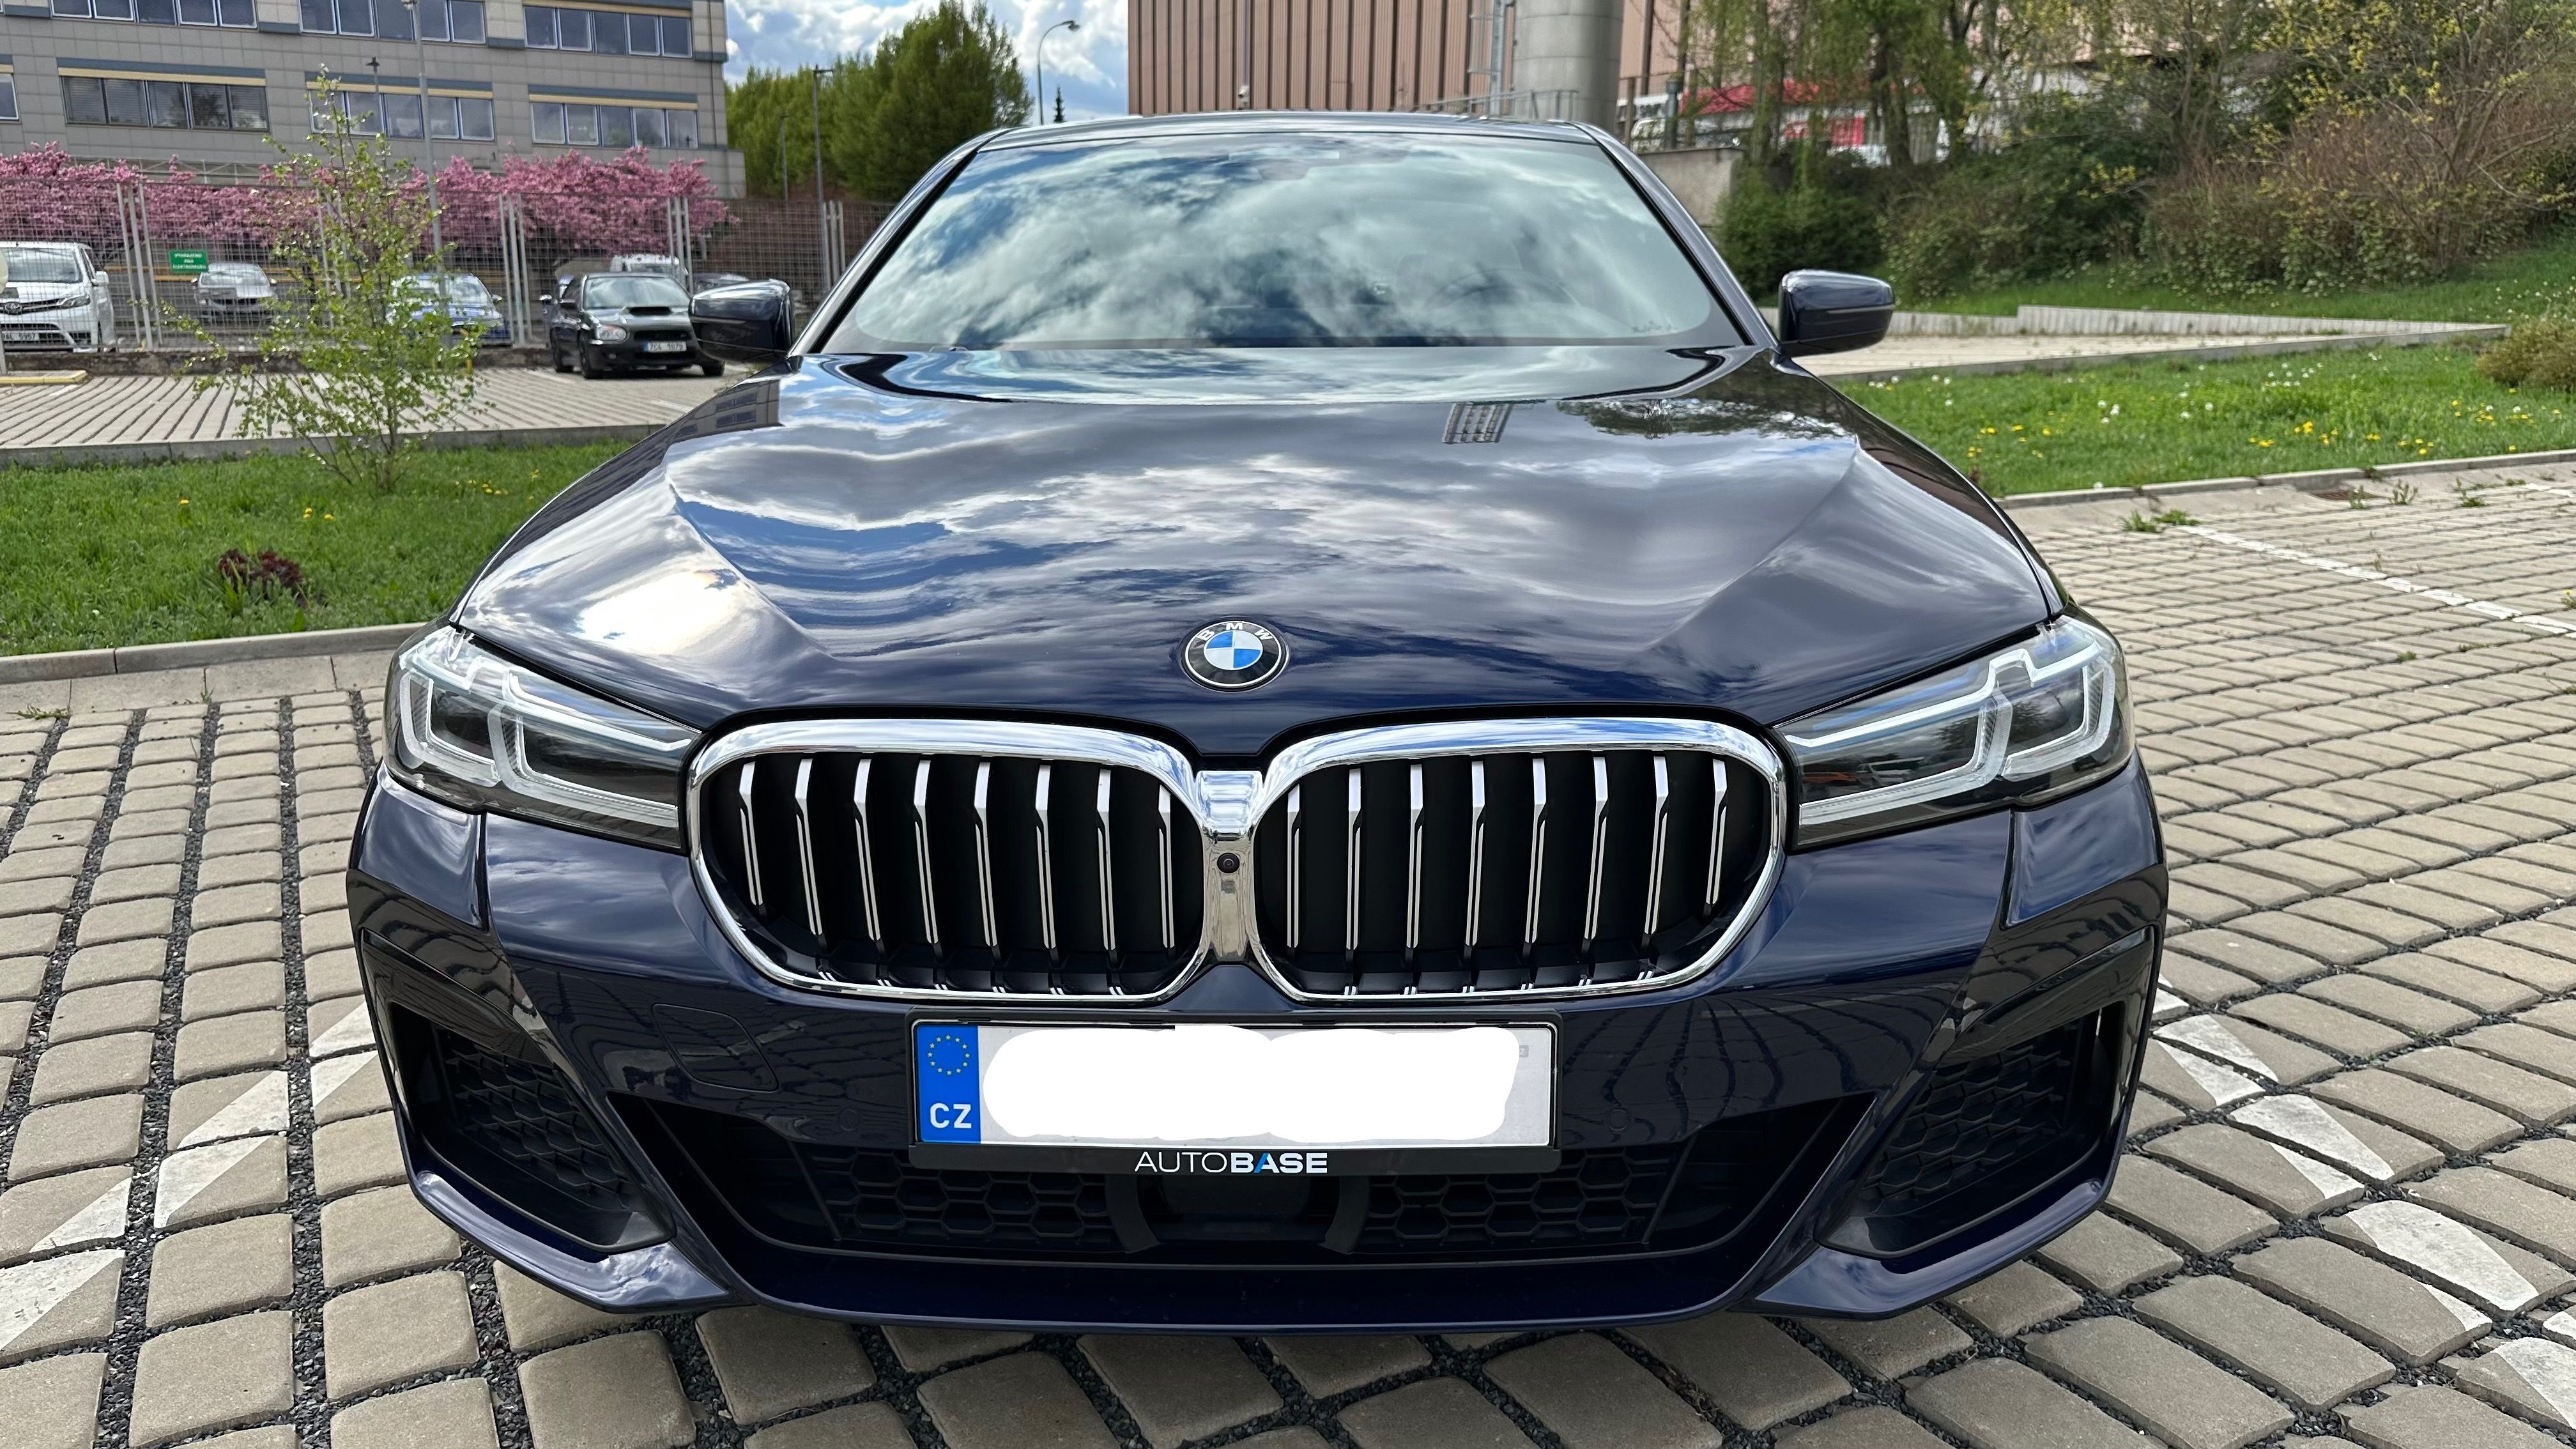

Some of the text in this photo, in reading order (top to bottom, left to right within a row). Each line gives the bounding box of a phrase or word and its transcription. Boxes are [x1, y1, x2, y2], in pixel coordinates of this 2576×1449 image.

[1196, 622, 1273, 640] BMW
[930, 1102, 972, 1129] CZ
[1134, 1151, 1328, 1174] AUTOBASE
